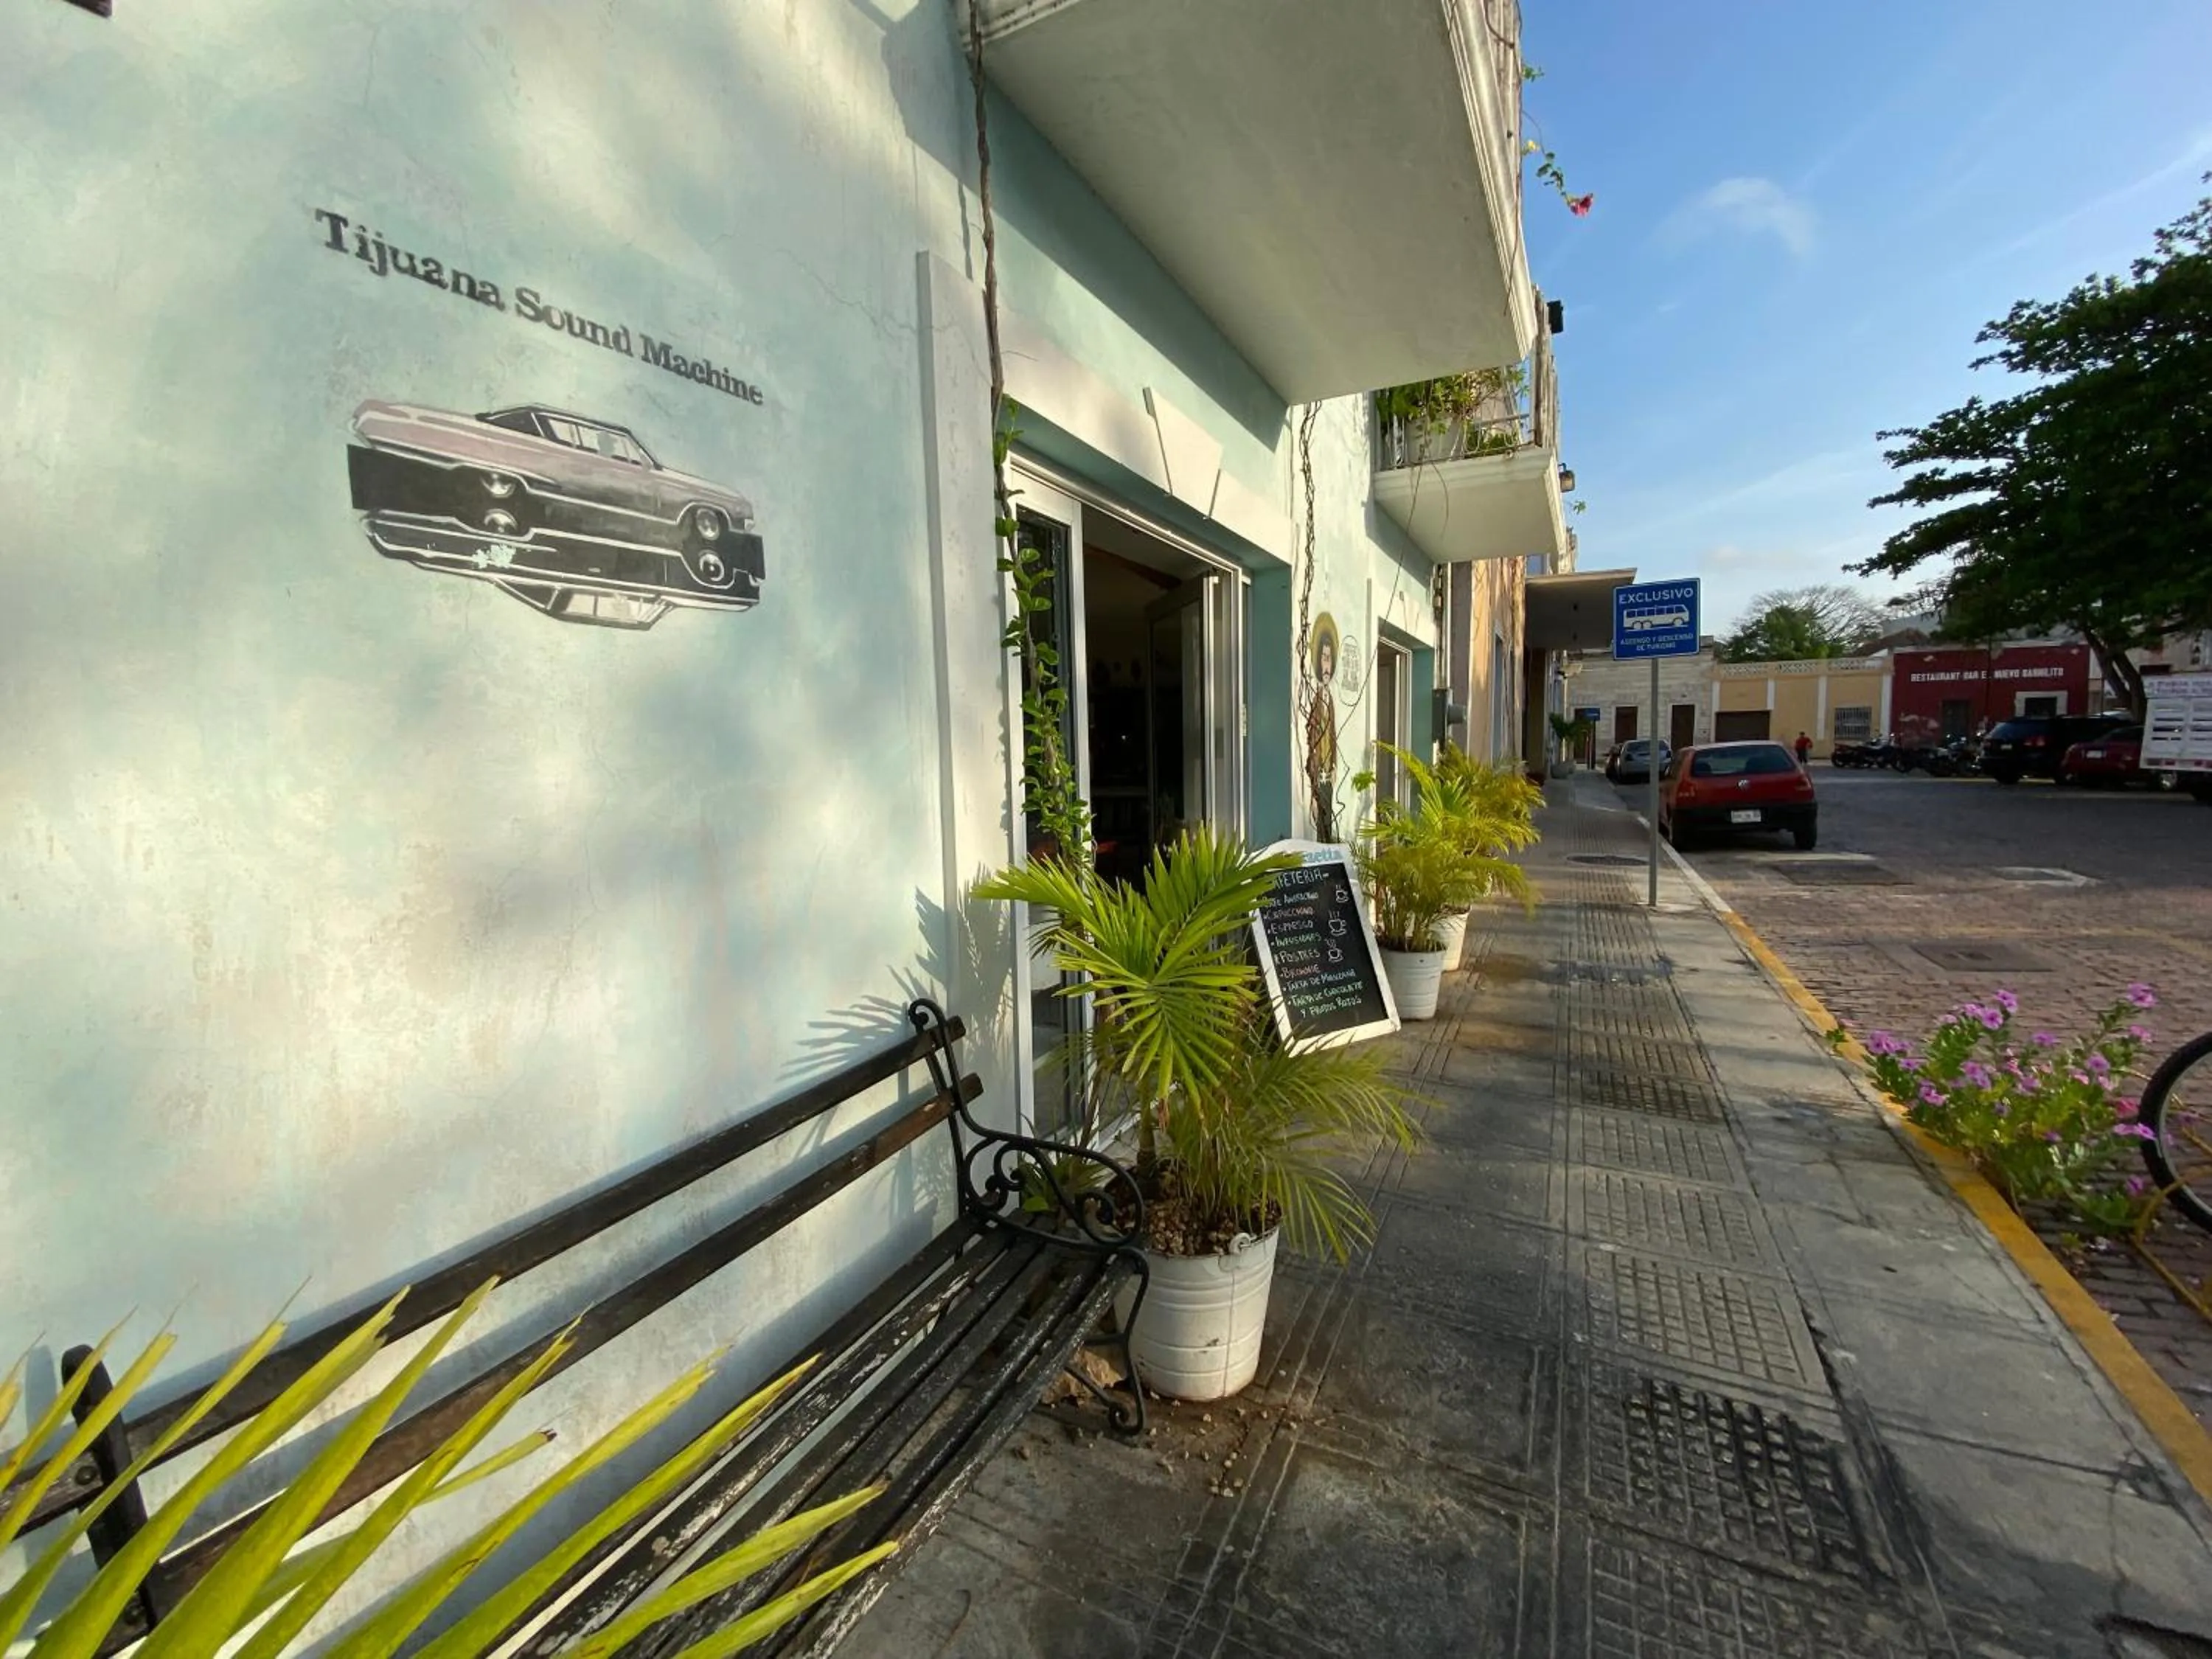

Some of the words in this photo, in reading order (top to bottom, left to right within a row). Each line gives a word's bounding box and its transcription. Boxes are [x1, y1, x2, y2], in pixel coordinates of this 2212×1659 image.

[316, 208, 506, 312] Tijuana
[515, 286, 633, 357] Sound
[639, 333, 764, 406] Machine
[1618, 588, 1694, 604] EXCLUSIVO
[1910, 671, 1960, 682] RESTAURANT
[1994, 669, 2020, 679] NUEVO
[1279, 949, 1321, 963] POSTRES
[1281, 964, 1321, 978] BROWNIE
[1310, 978, 1320, 987] DE
